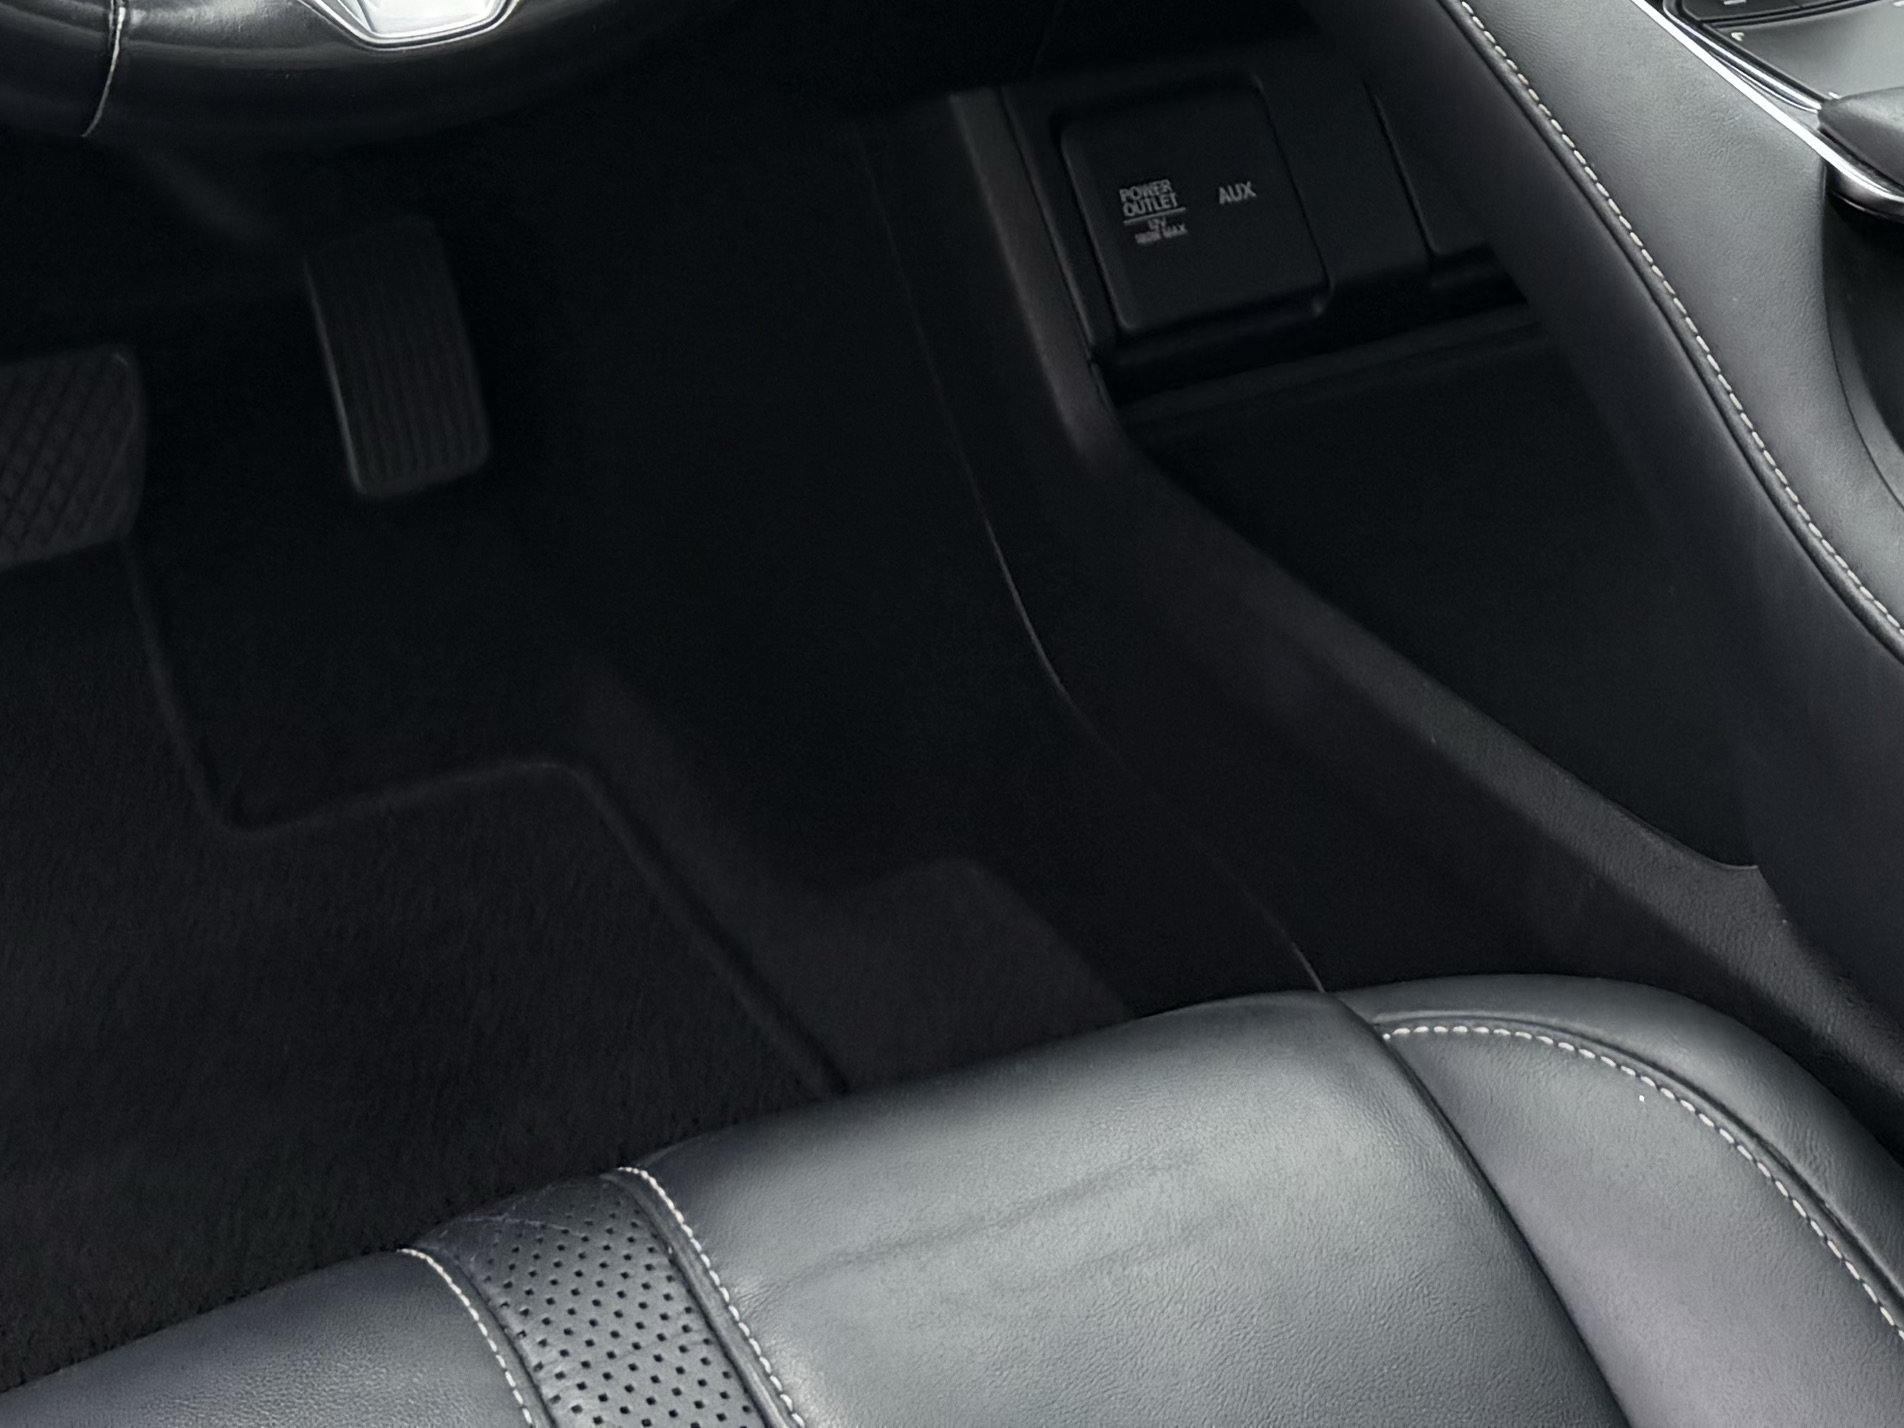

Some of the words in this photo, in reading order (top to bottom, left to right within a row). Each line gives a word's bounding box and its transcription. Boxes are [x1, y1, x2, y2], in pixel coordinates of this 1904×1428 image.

[1119, 179, 1174, 202] POWER
[1218, 180, 1257, 205] AUX
[1123, 192, 1179, 217] OUTLET
